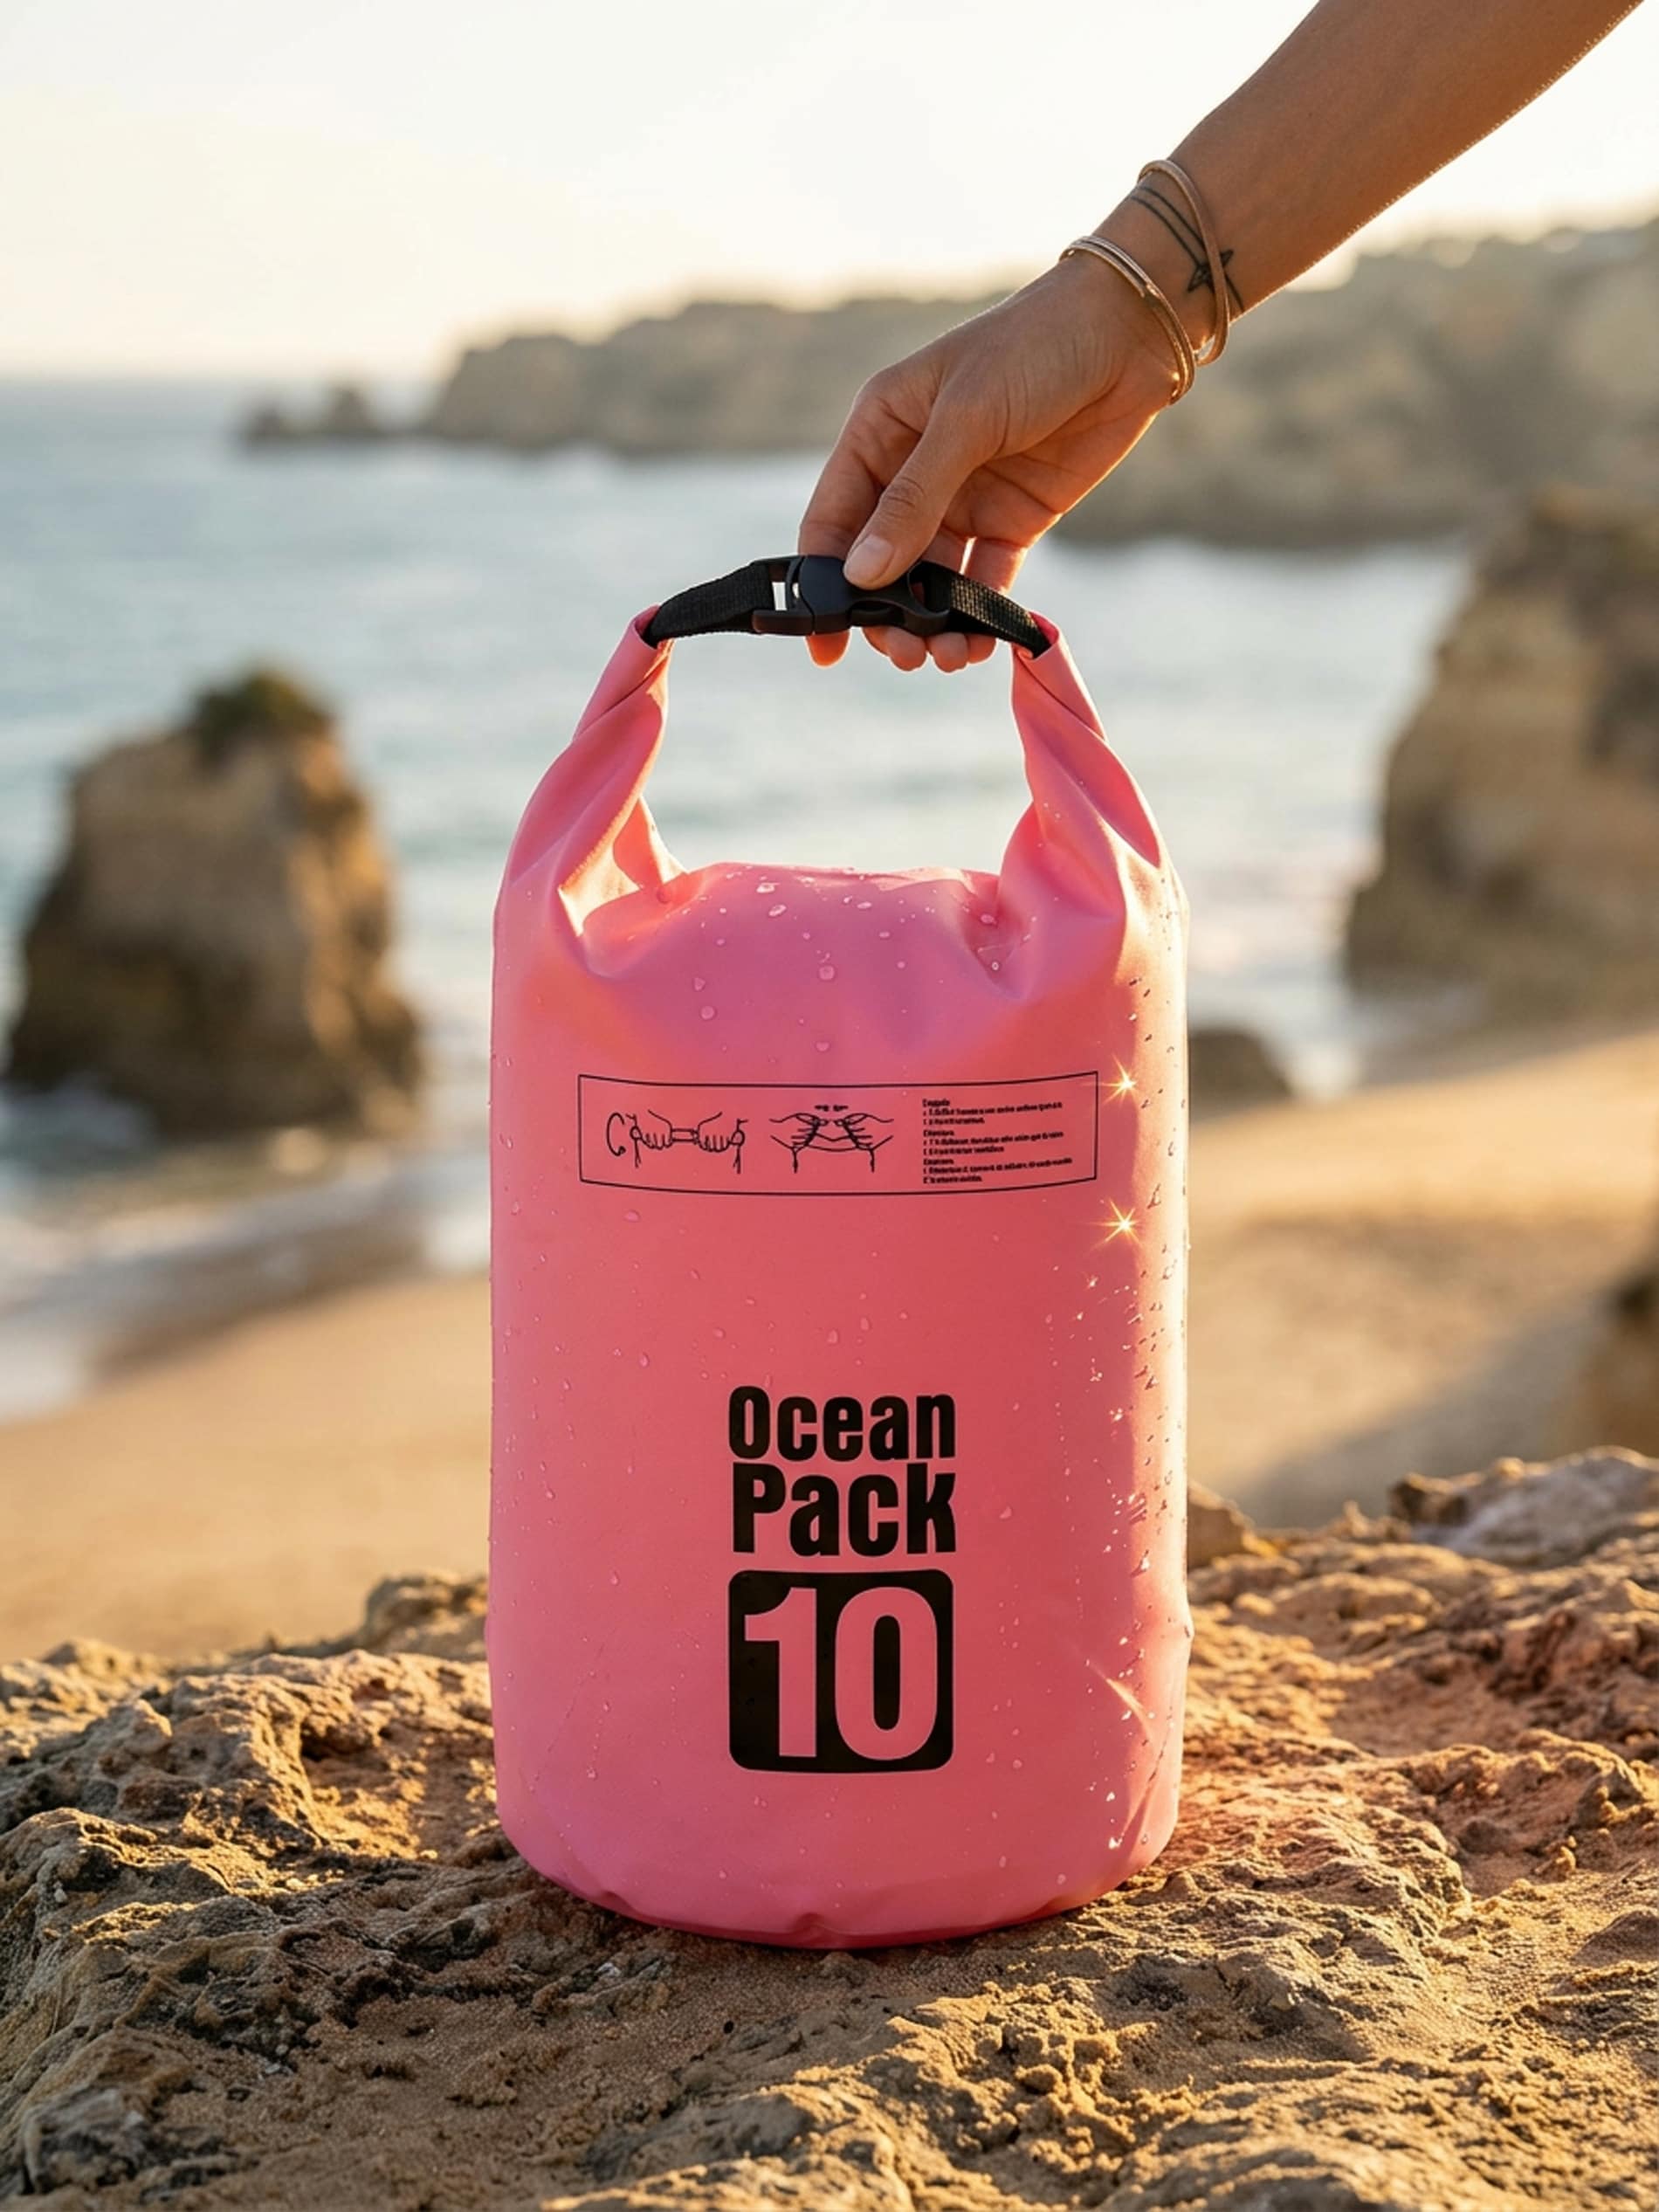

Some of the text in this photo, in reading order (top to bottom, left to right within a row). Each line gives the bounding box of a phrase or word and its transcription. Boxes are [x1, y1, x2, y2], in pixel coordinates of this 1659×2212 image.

[729, 1386, 956, 1462] Ocean
[733, 1462, 956, 1557] Pack
[745, 1586, 939, 1761] 10
